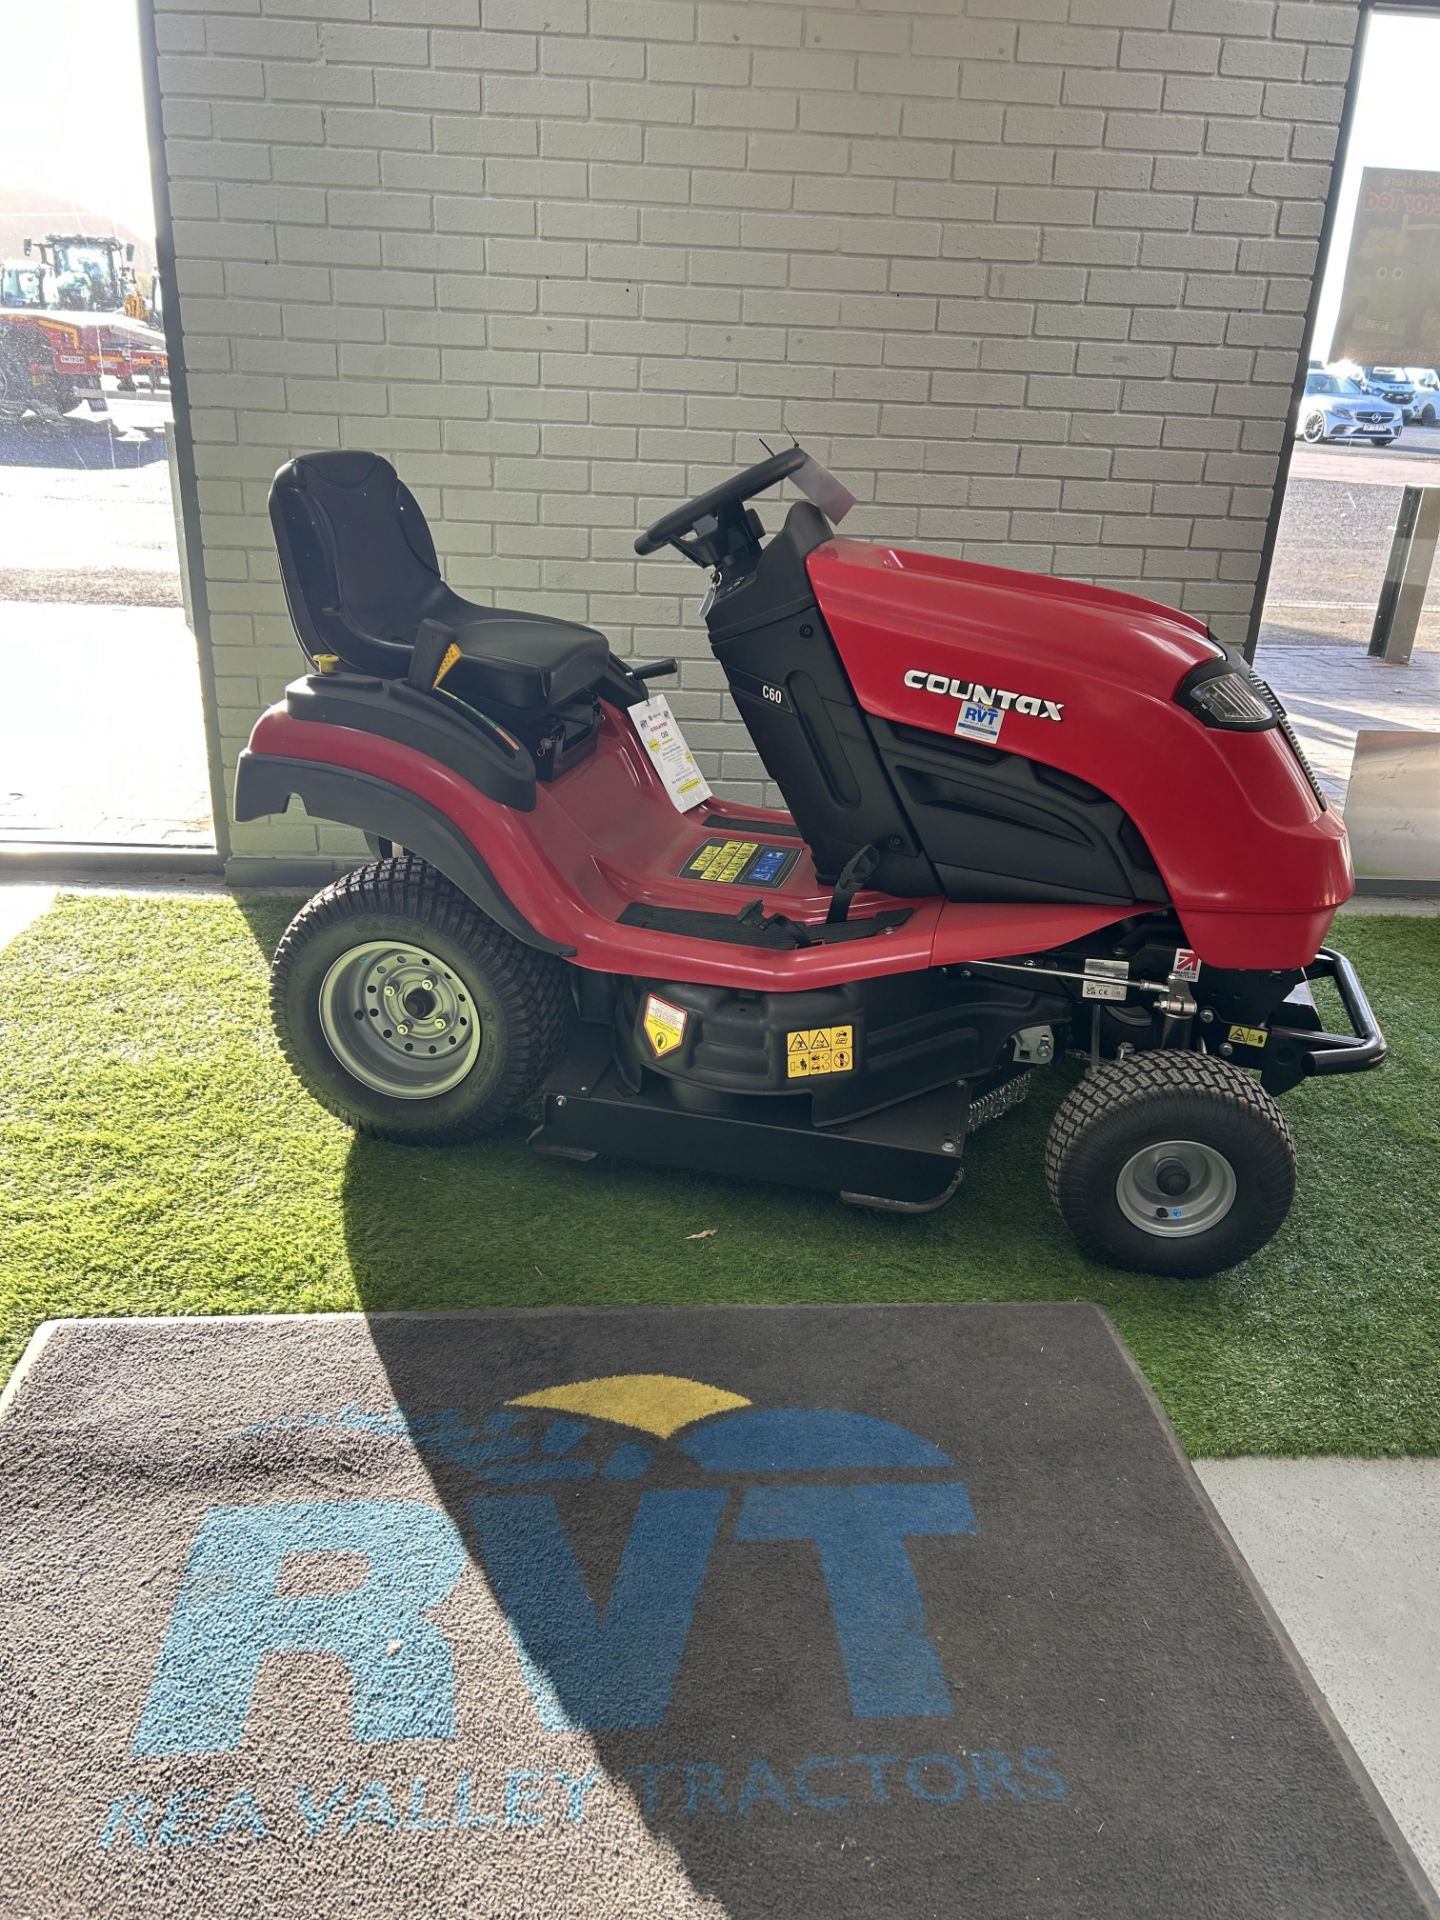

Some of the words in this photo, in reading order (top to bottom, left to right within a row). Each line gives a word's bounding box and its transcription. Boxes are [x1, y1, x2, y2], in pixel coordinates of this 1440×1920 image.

[762, 685, 782, 704] C60
[964, 706, 999, 726] RVT
[132, 1482, 981, 1759] RVT
[100, 1787, 269, 1850] REA
[296, 1767, 602, 1836] VALLEY
[626, 1745, 1069, 1816] TRACTORS
